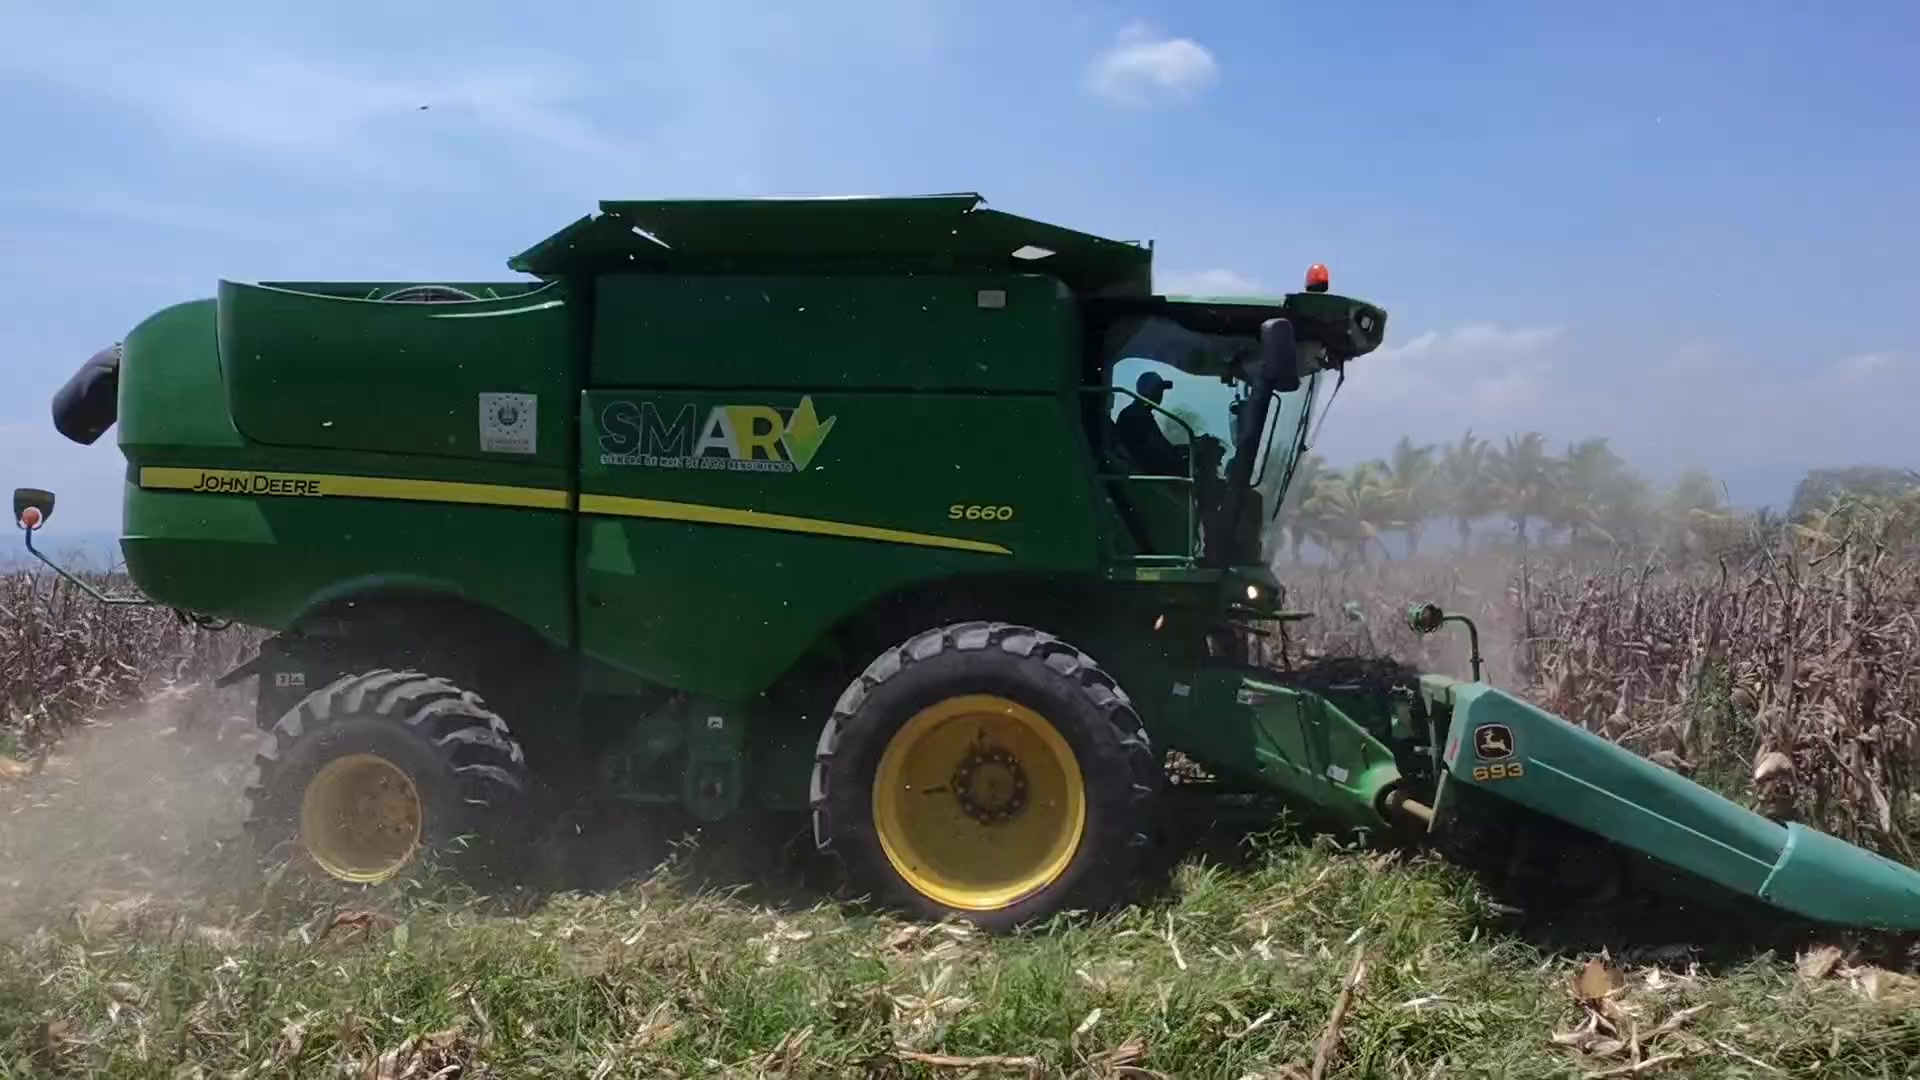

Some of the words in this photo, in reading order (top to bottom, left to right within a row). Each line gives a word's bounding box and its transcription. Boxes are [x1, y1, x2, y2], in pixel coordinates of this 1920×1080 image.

[194, 473, 249, 492] JOHN
[252, 475, 321, 495] DEERE
[948, 504, 1014, 520] S660
[1472, 761, 1525, 780] 693
